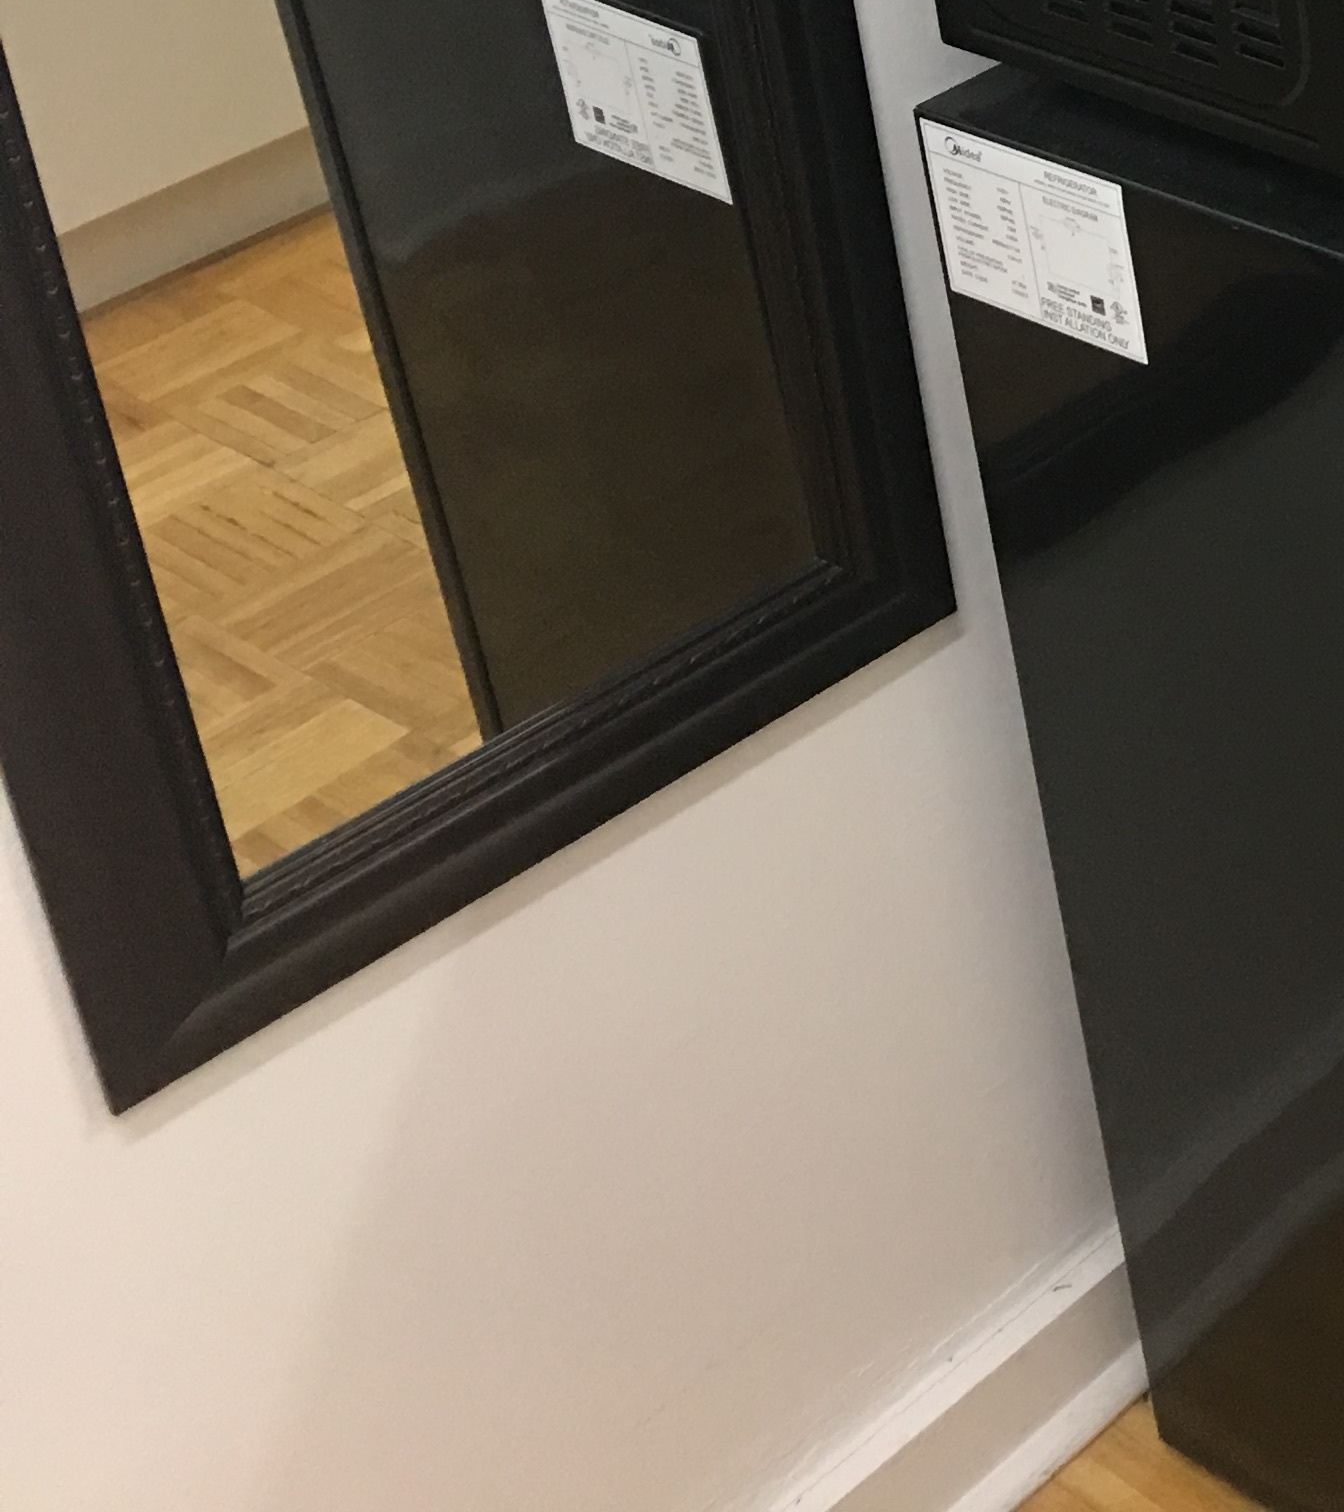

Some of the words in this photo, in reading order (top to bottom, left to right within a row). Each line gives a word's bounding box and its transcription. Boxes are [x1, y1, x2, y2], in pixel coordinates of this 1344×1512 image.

[944, 135, 982, 162] Midea
[1041, 296, 1065, 313] FREE
[1066, 306, 1112, 333] STANDING
